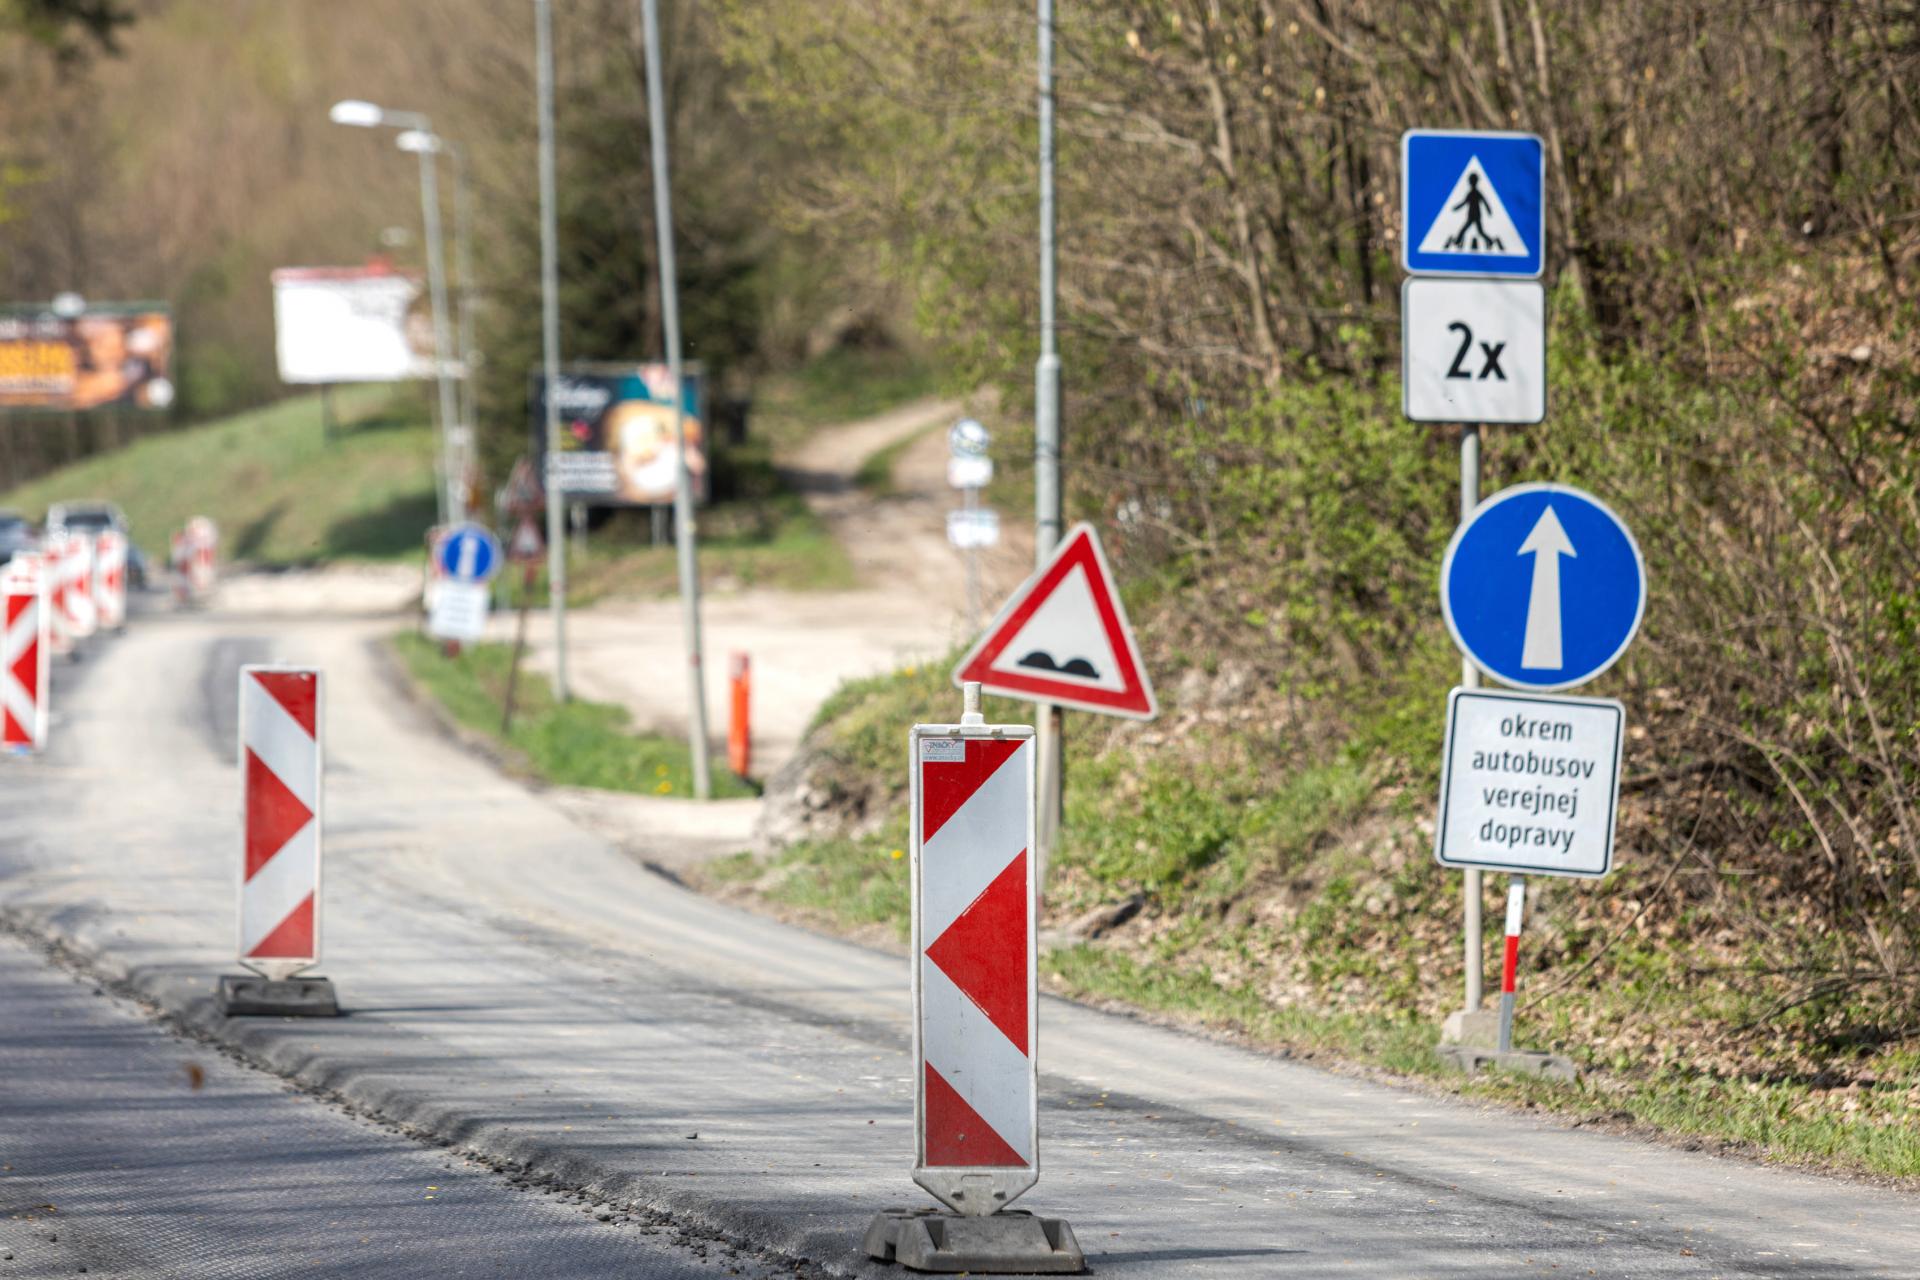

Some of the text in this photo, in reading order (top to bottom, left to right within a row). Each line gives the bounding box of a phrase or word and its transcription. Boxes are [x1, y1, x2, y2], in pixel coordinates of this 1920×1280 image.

[1446, 322, 1507, 381] 2x
[1500, 714, 1573, 741] okrem
[1472, 750, 1595, 779] autobusov
[1483, 785, 1578, 818] verejnej
[1480, 818, 1575, 853] dopravy
